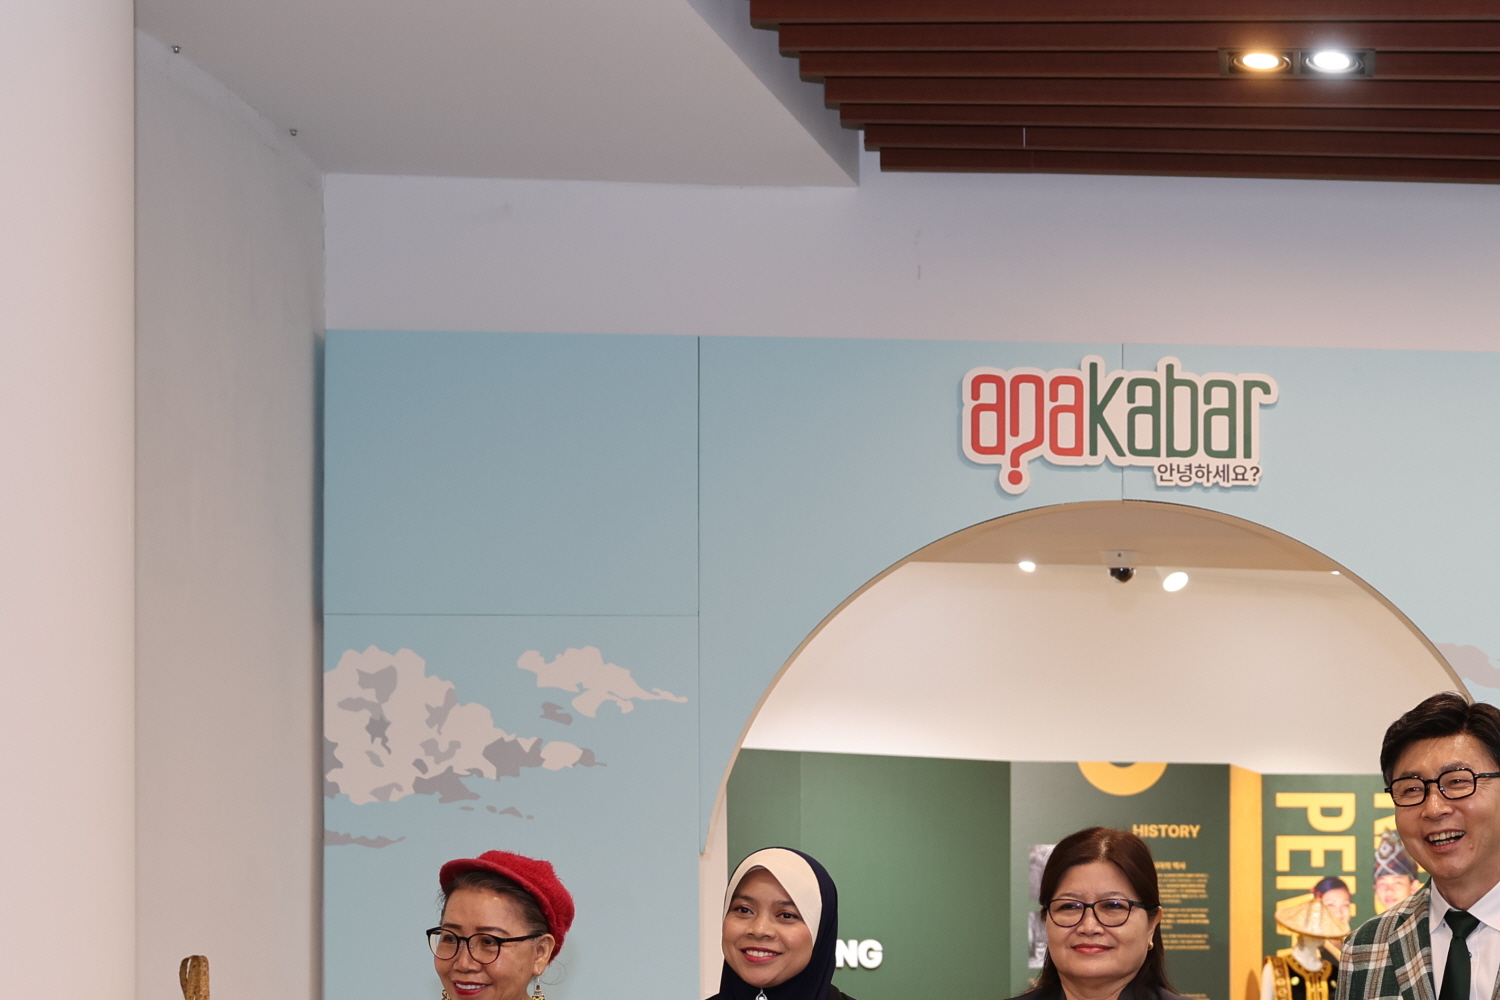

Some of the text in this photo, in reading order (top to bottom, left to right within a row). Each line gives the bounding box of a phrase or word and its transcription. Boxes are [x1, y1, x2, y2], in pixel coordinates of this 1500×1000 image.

[1156, 463, 1261, 484] 안녕하세요?
[1131, 824, 1201, 838] HISTORY
[835, 939, 883, 969] NG
